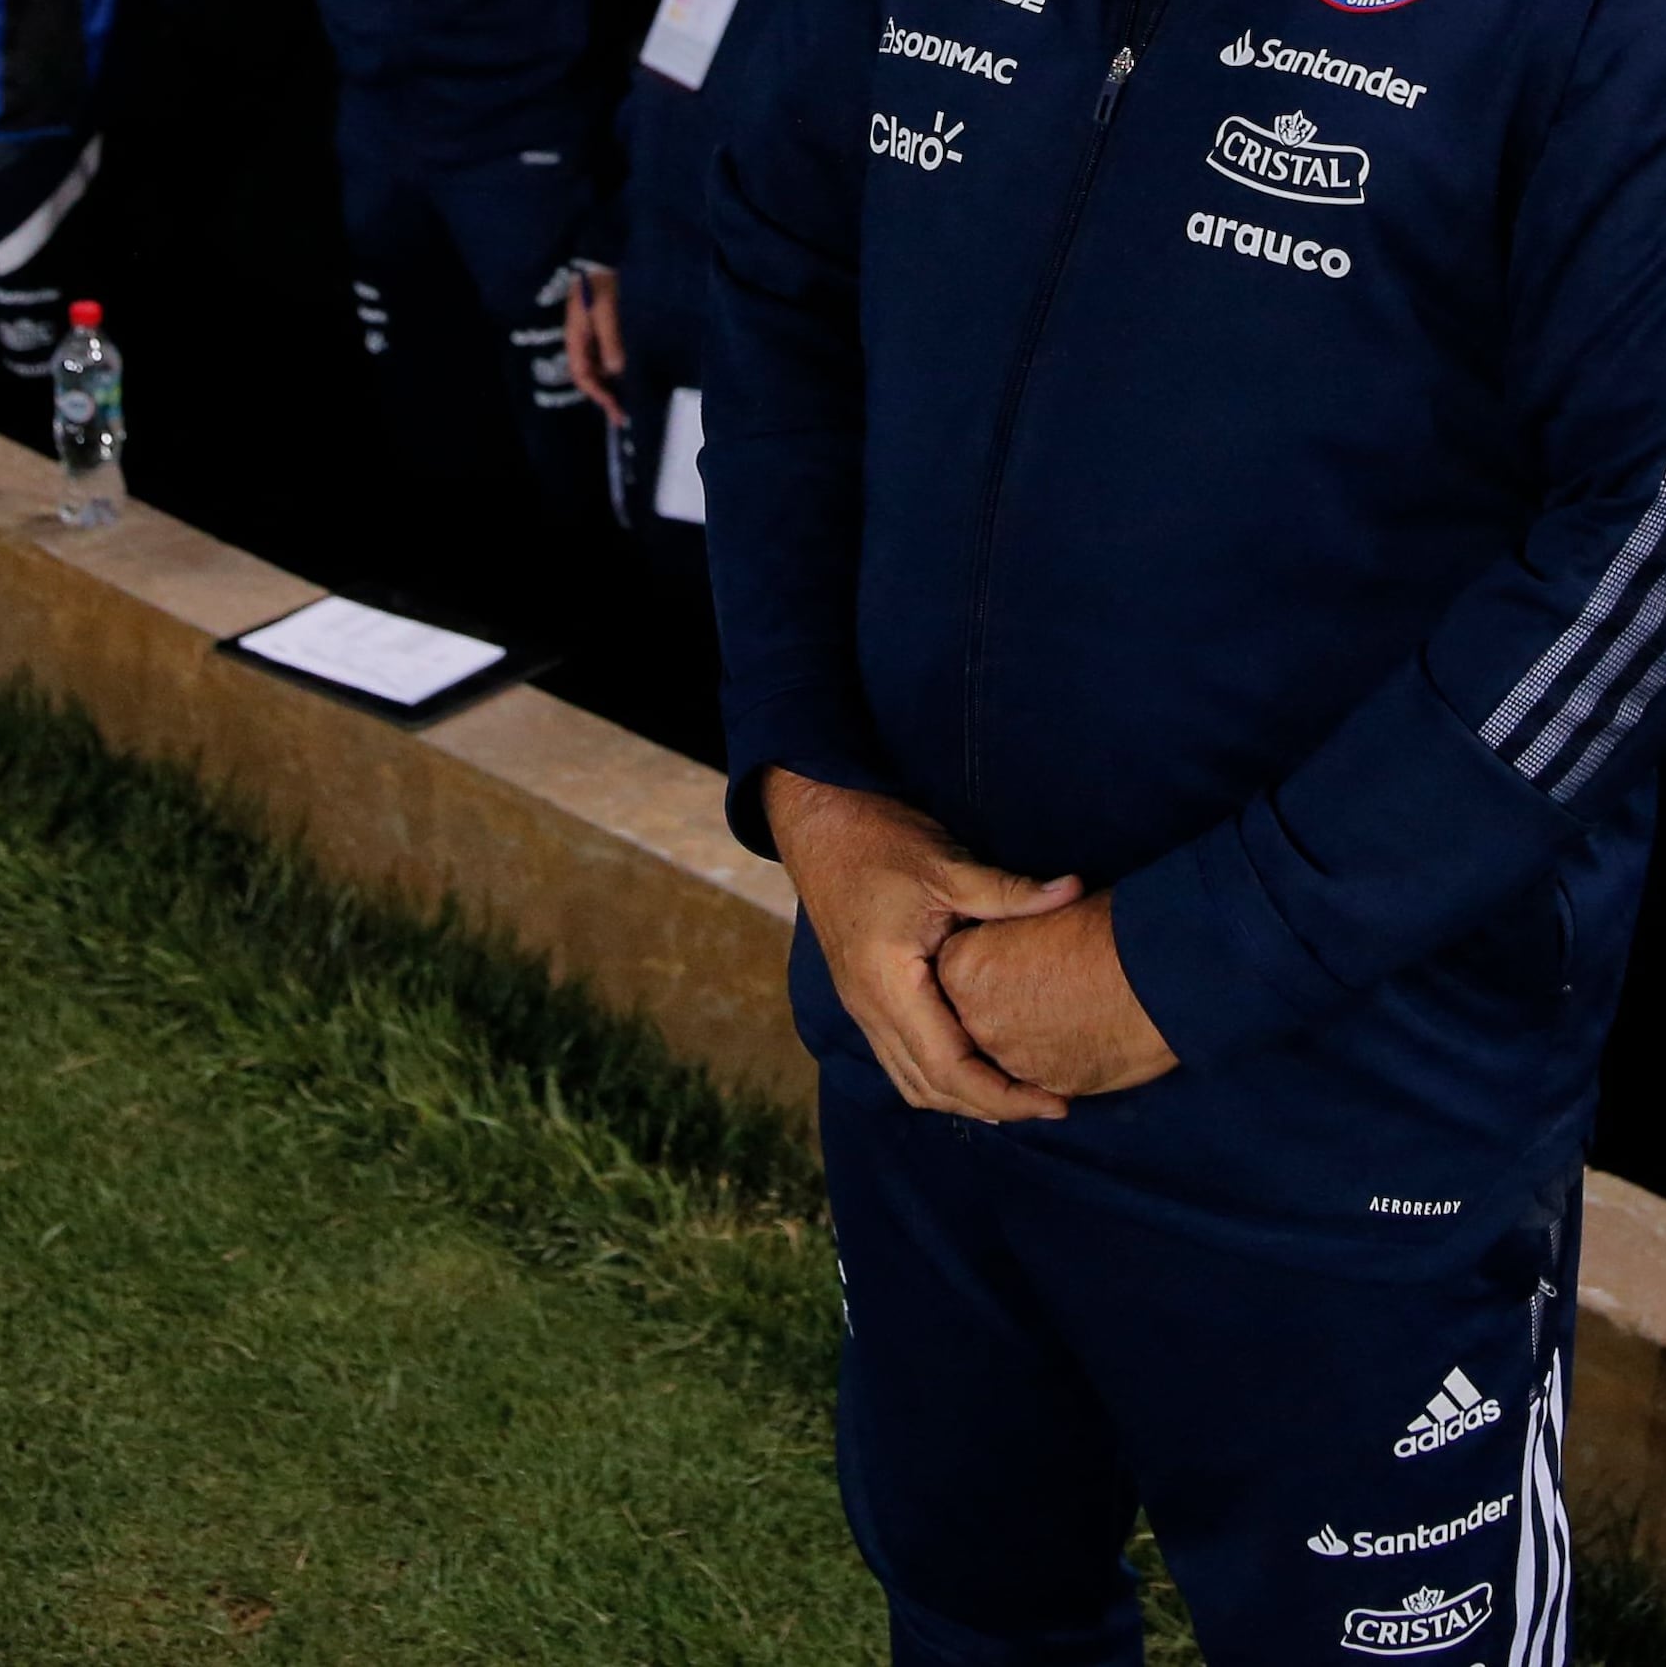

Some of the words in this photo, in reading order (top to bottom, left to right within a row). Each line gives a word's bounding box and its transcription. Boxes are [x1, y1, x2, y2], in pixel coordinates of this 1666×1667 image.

[892, 29, 1018, 86] SODIMAC
[1254, 38, 1428, 110] Santander
[869, 111, 946, 172] Claro
[1221, 131, 1352, 190] CRISTAL
[1186, 211, 1352, 279] arauco
[1369, 1195, 1462, 1216] AEROREADY
[1393, 1394, 1502, 1459] adidas
[1352, 1491, 1514, 1559] Santander
[1356, 1599, 1483, 1646] CRISTAL
